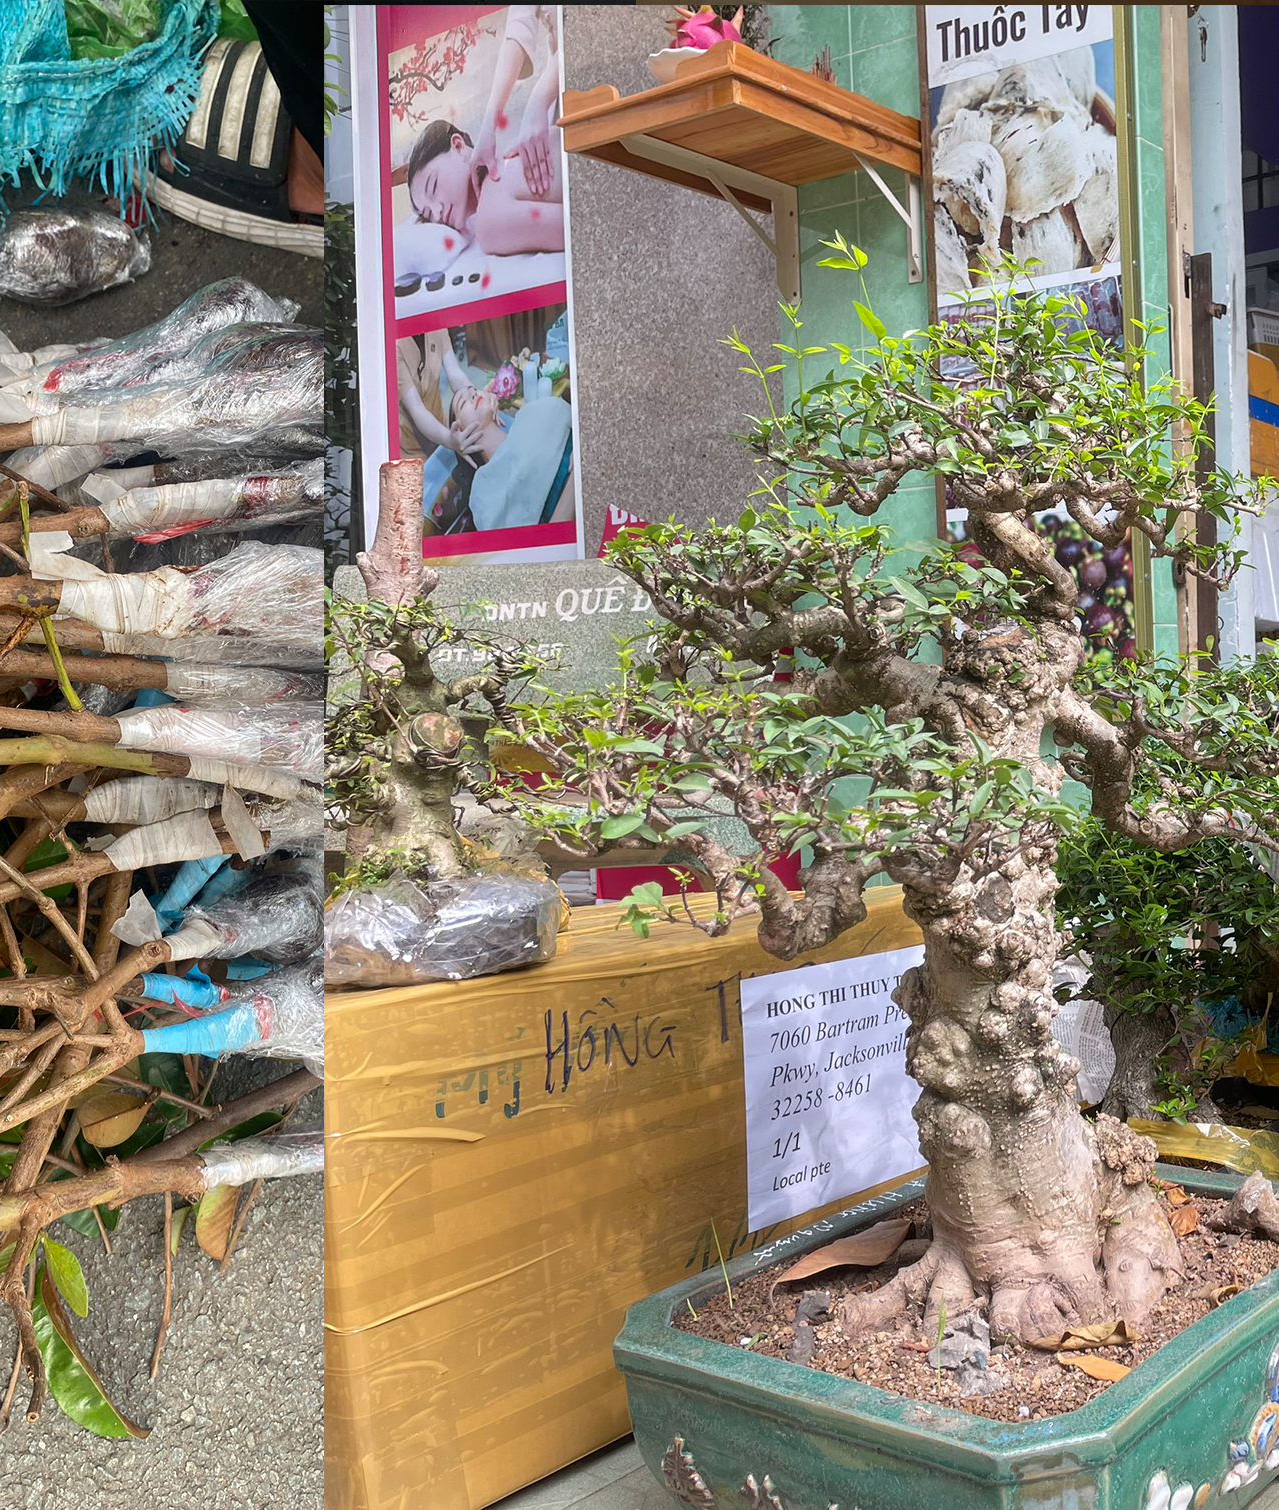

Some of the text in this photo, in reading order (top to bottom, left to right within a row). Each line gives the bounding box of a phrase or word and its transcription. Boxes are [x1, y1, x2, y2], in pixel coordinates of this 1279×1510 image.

[555, 575, 628, 622] QUÊ
[766, 993, 815, 1019] HONG
[819, 987, 847, 1006] THI
[850, 977, 890, 1000] THUY
[770, 1025, 811, 1053] 7060
[815, 1013, 879, 1042] Bartram
[770, 1032, 907, 1088] Pkwy, Jacksonvill
[771, 1073, 871, 1121] 32258 -8461
[772, 1132, 801, 1159] 1/1
[773, 1161, 831, 1192] Local pte
